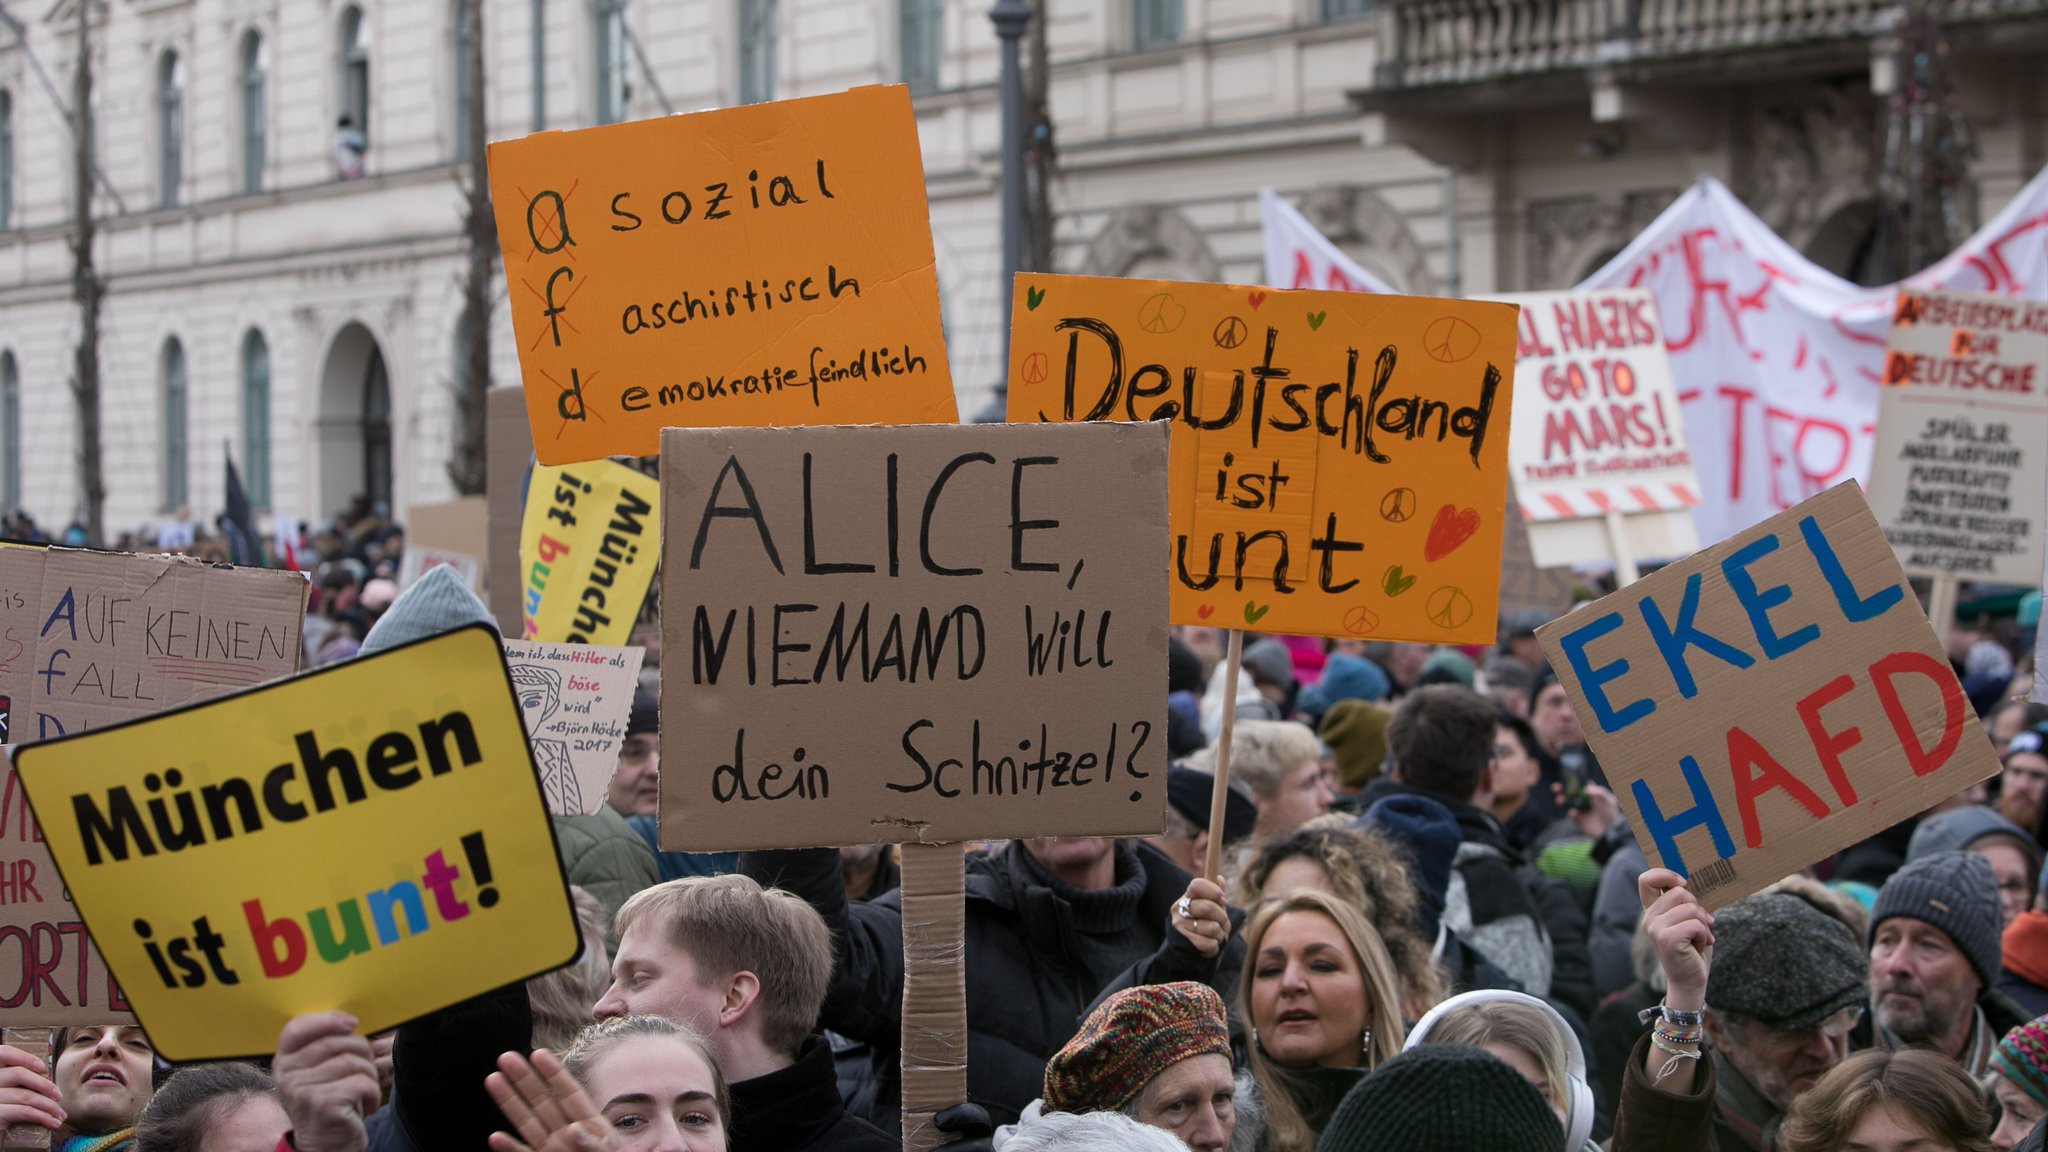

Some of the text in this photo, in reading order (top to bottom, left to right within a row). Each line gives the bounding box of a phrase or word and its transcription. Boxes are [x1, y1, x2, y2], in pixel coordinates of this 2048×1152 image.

[611, 159, 834, 231] sozial
[1552, 298, 1655, 352] NAZIS
[621, 345, 927, 406] emokratiefeindlich
[1039, 317, 1501, 469] Deutschland
[1541, 358, 1636, 401] GO TO
[1887, 351, 2036, 392] DEUTSCHE
[1543, 391, 1673, 460] MARS!
[547, 471, 593, 528] ist
[1215, 452, 1290, 512] ist
[689, 451, 1085, 590] ALICE,
[1169, 511, 1365, 594] unt
[566, 487, 652, 645] Münch
[40, 586, 287, 661] AUF KEINEN
[548, 648, 570, 662] dass
[571, 650, 607, 665] Hitler
[609, 652, 625, 669] als
[691, 601, 986, 687] NIEMAND
[1559, 515, 1905, 734] EKEL
[567, 675, 601, 692] böse
[556, 719, 622, 738] Björn Höcke
[573, 739, 613, 752] 2017
[712, 719, 1152, 803] dein Schnitzel?
[71, 711, 483, 866] München
[1630, 651, 1966, 880] HAFD
[133, 831, 502, 990] ist bunt!
